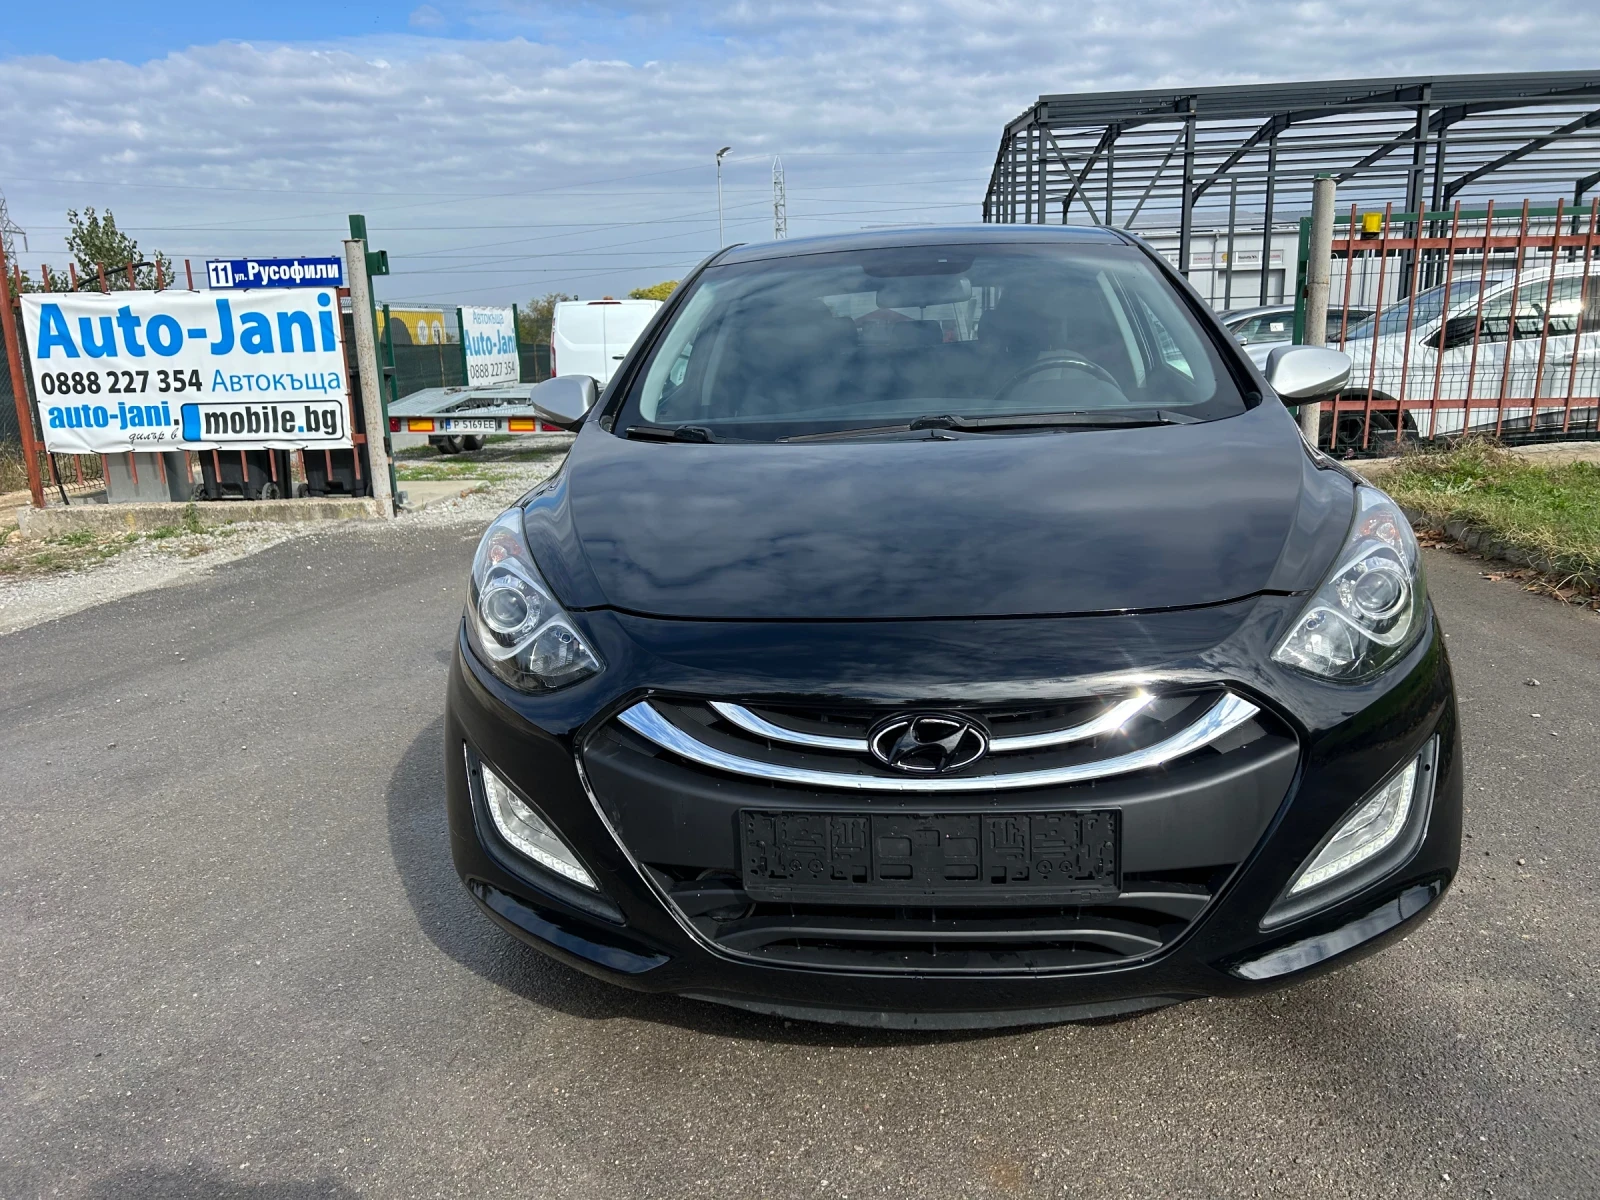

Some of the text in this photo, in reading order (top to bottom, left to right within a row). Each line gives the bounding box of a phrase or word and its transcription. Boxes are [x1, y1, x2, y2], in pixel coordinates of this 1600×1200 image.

[211, 261, 339, 285] 11 ул. Русофили
[37, 292, 337, 359] Auto-Jani
[472, 310, 504, 327] Автокъща
[464, 328, 516, 356] Auto-Jani
[41, 369, 202, 395] 0888 227 354
[211, 369, 341, 395] Автокъща
[470, 361, 515, 379] 0888 227 354
[204, 405, 337, 435] mobile.bg
